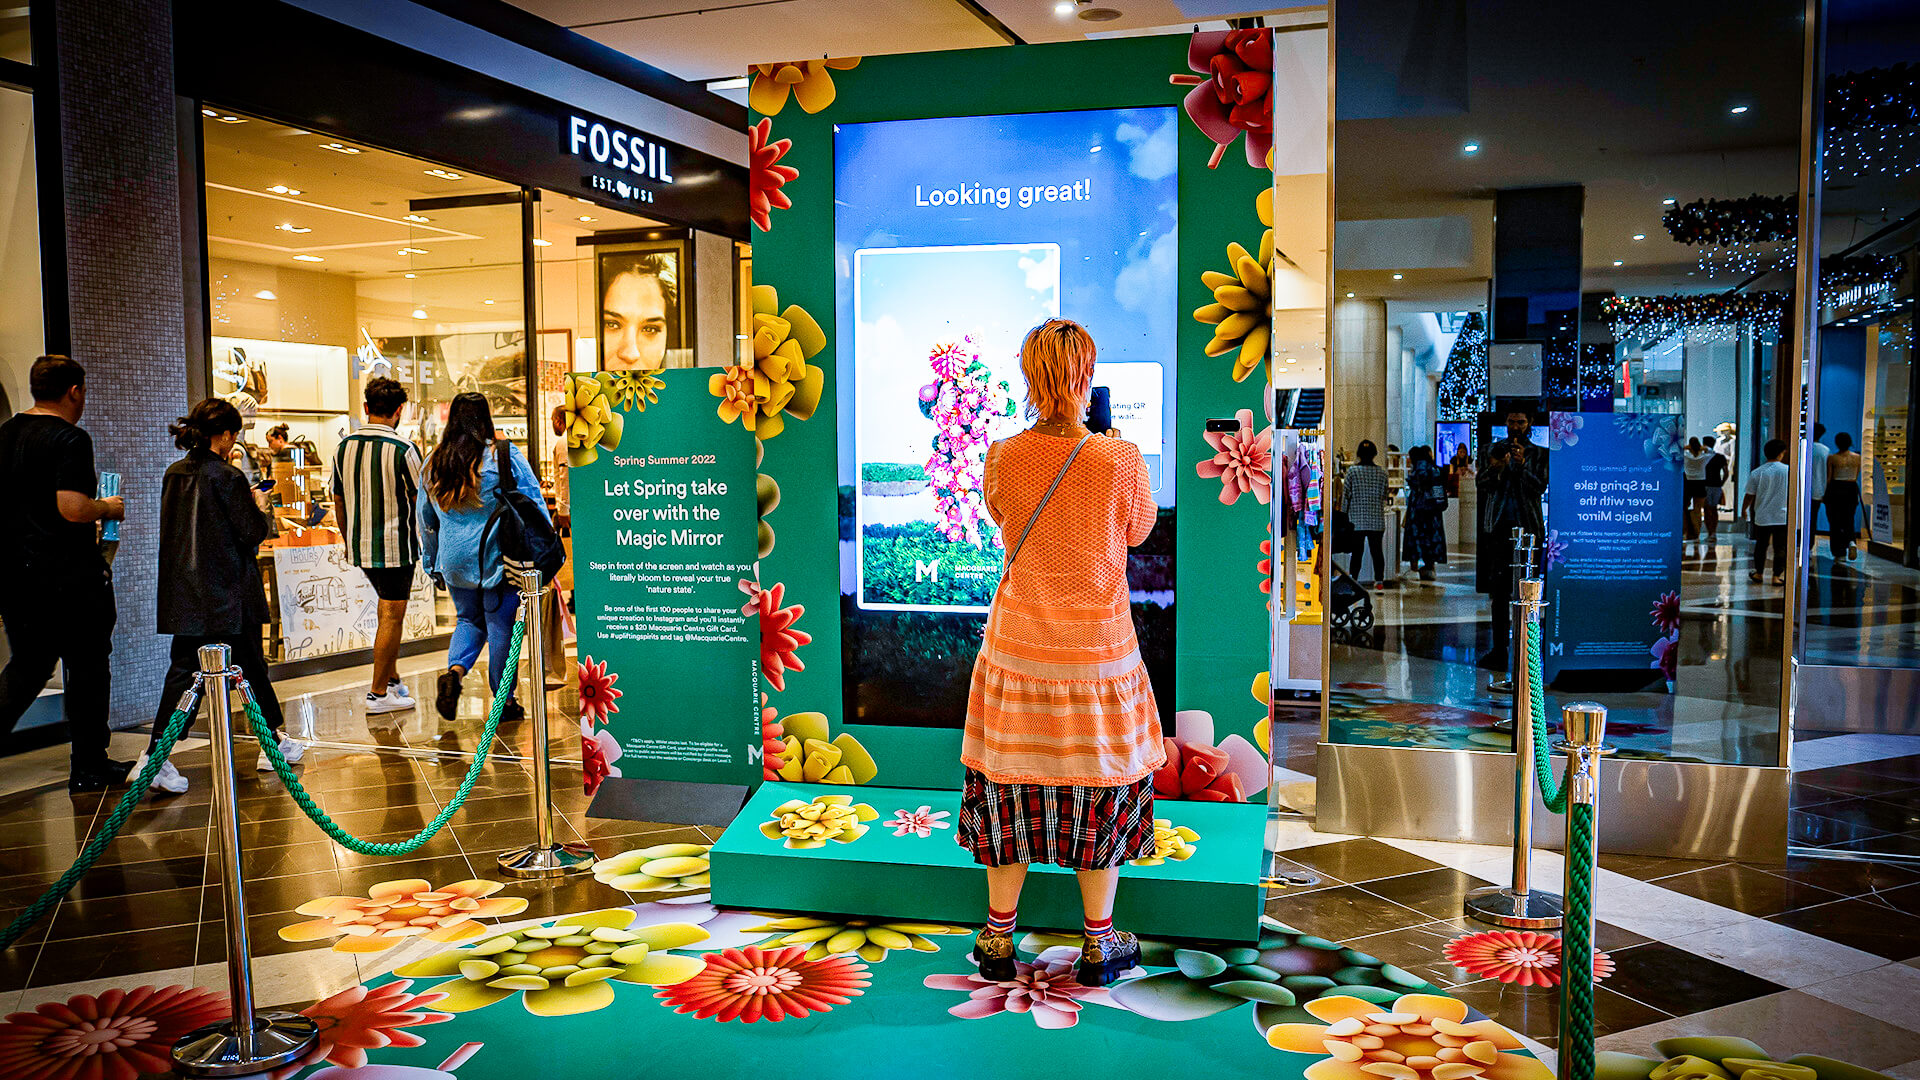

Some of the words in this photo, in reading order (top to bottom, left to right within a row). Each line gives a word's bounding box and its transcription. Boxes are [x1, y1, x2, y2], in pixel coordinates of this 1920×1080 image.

[571, 115, 672, 184] FOSSIL
[592, 175, 616, 192] EST.
[634, 188, 654, 204] USA
[914, 181, 1011, 208] Looking
[1018, 179, 1092, 208] great!
[1110, 402, 1131, 410] ating
[614, 455, 645, 467] Spring
[648, 455, 689, 465] Summer
[692, 455, 716, 464] 2022
[604, 480, 630, 496] Let
[634, 480, 686, 499] Spring
[691, 478, 727, 495] take
[613, 507, 649, 521] over
[653, 505, 689, 520] with
[692, 505, 720, 520] the
[617, 529, 667, 549] Magic
[672, 529, 723, 546] Mirror
[294, 552, 318, 562] HOURS
[590, 562, 607, 571] Step
[608, 562, 615, 570] in
[617, 562, 634, 570] front
[636, 562, 644, 570] of
[645, 562, 657, 570] the
[686, 562, 699, 570] and
[701, 562, 724, 570] watch
[737, 564, 751, 573] you
[916, 558, 940, 582] M
[610, 573, 636, 583] literally
[638, 573, 661, 582] bloom
[663, 574, 670, 582] to
[672, 574, 695, 582] reveal
[696, 576, 713, 584] your
[715, 575, 731, 583] true
[672, 606, 694, 615] people
[654, 616, 684, 624] Instagram
[649, 625, 682, 633] Macquarie
[707, 625, 719, 633] Gift
[610, 632, 659, 641] #upliftingspirits
[674, 634, 683, 642] tag
[685, 634, 749, 643] @MacquarieCentre.
[748, 744, 764, 766] M
